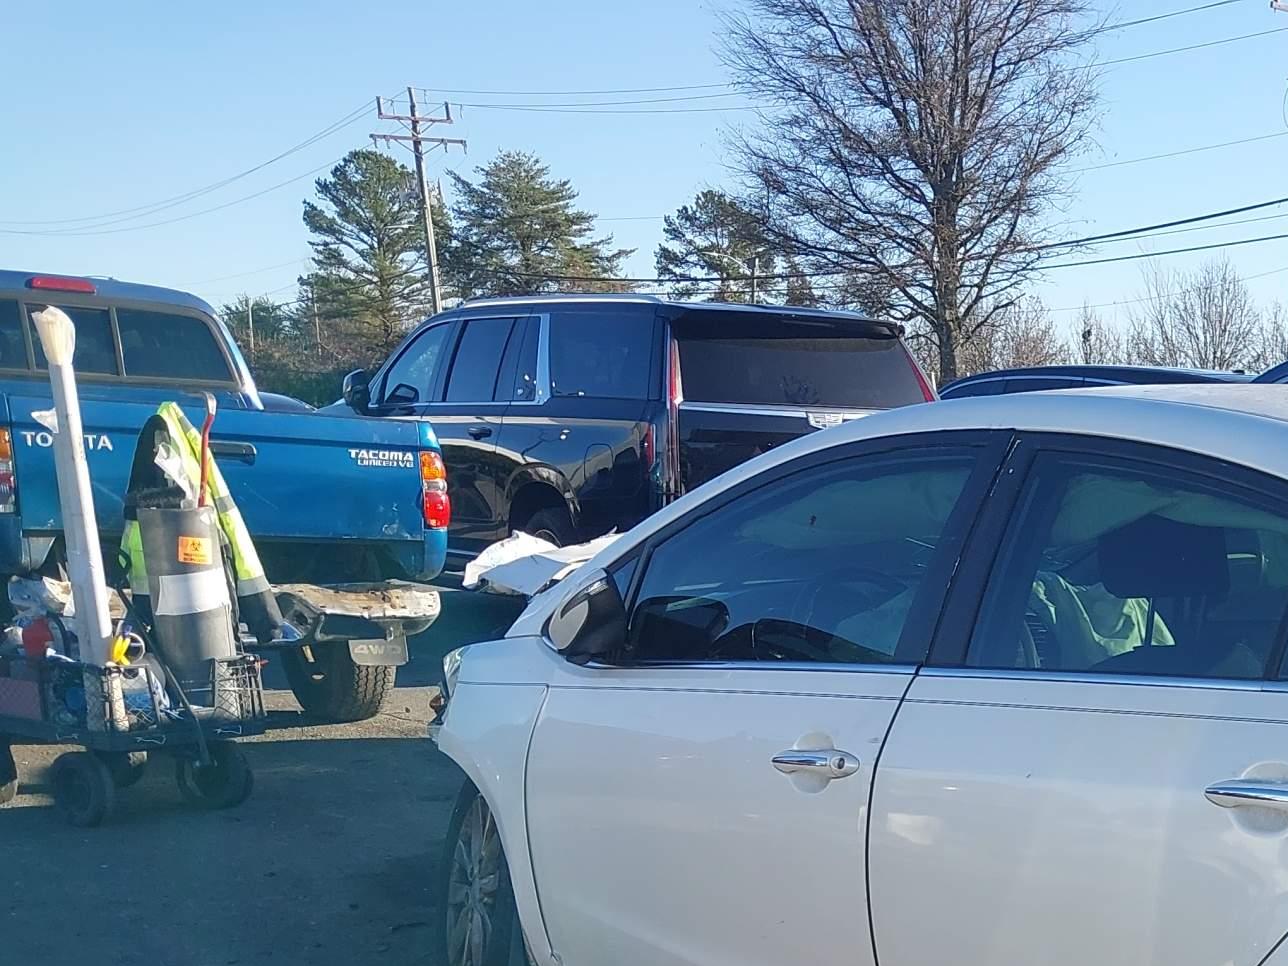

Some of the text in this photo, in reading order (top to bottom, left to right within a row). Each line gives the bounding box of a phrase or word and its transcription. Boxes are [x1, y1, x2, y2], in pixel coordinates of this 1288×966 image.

[20, 431, 114, 452] TOTA
[347, 448, 414, 461] TACOMA
[399, 460, 414, 468] V6
[353, 644, 402, 655] 4WD
